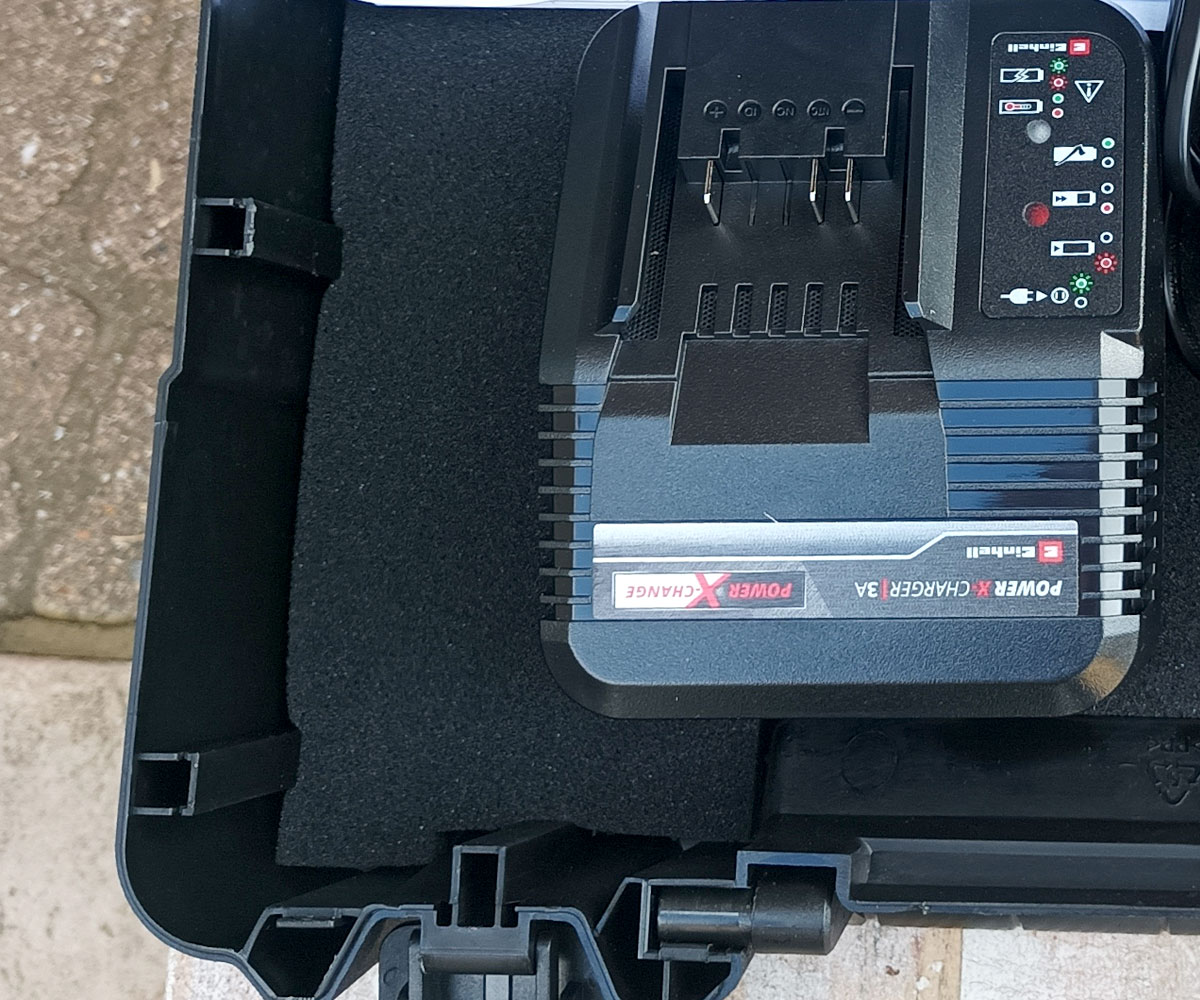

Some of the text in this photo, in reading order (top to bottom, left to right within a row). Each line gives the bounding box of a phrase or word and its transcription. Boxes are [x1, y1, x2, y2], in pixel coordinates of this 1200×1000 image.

[1008, 43, 1067, 53] Einhell
[966, 546, 1036, 559] Einhell
[728, 582, 793, 599] POWER
[854, 581, 879, 597] 3A
[993, 580, 1063, 597] POWER
